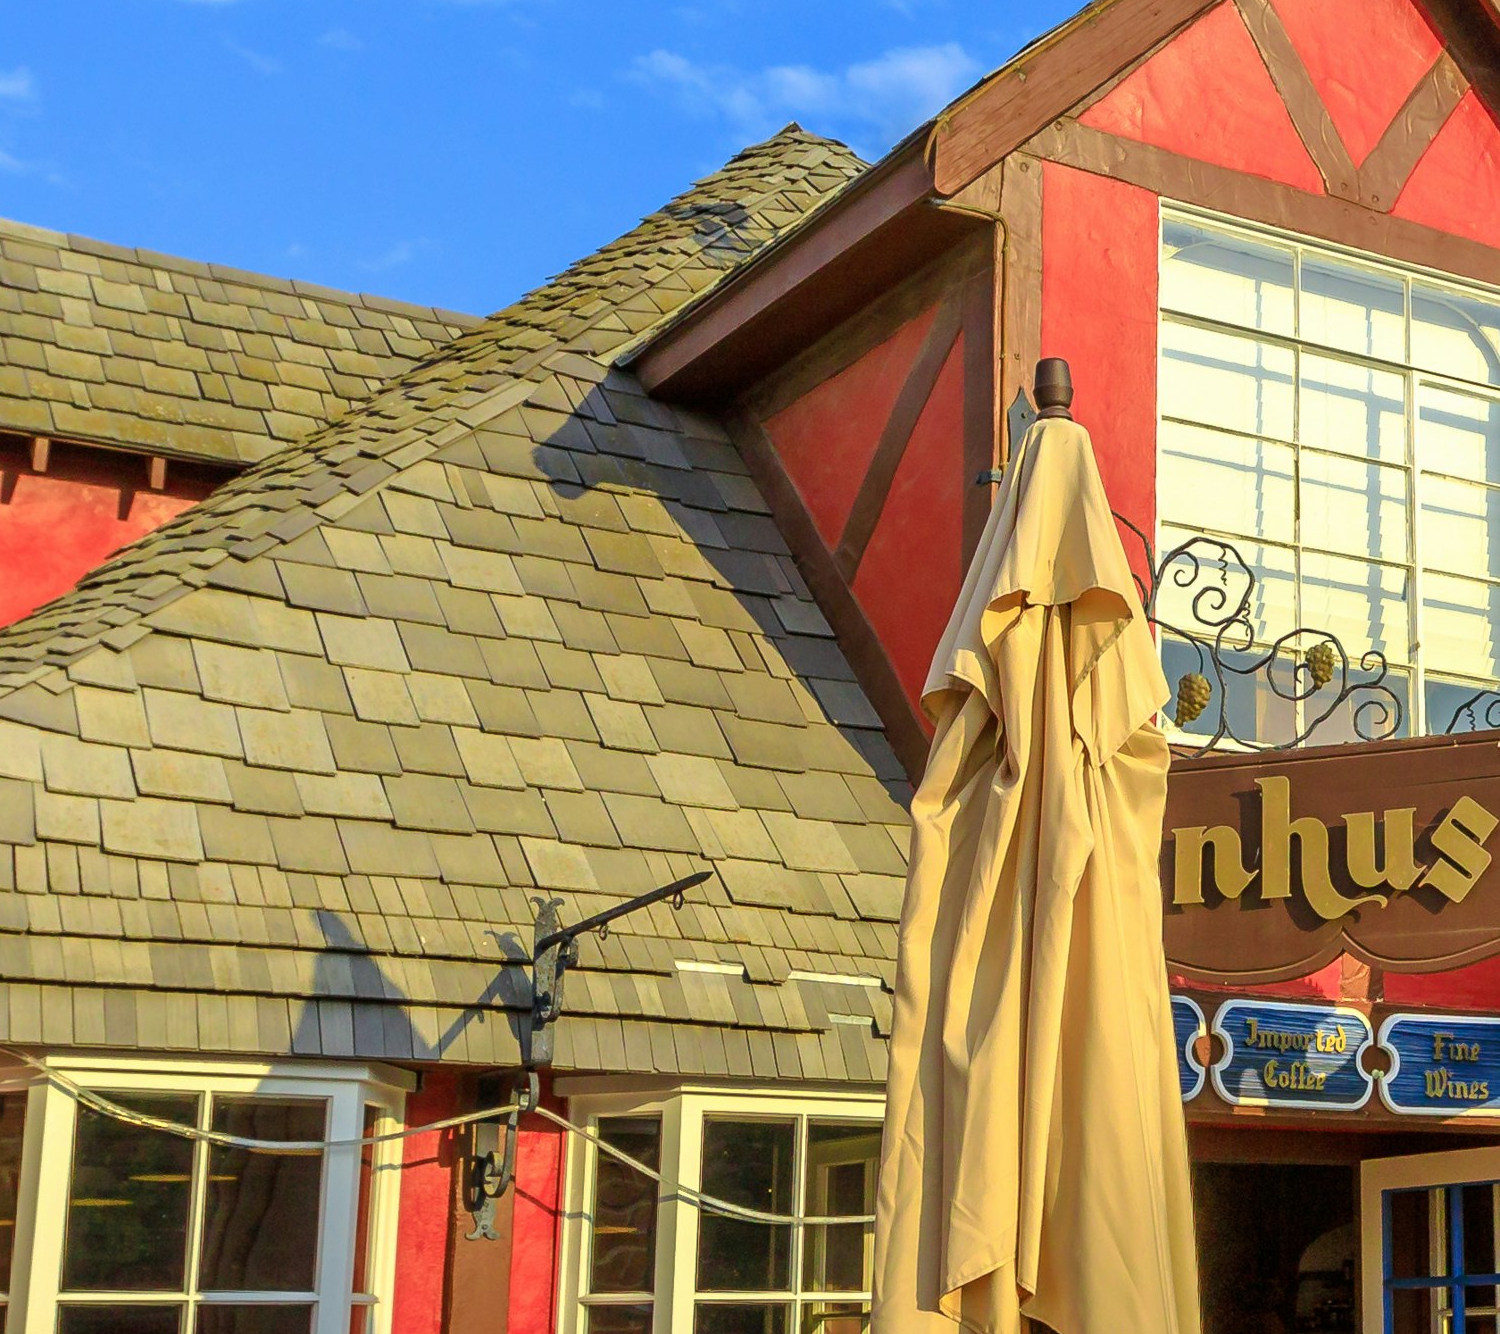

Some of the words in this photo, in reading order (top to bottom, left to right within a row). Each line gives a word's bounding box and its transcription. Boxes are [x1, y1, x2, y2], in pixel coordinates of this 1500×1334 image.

[1171, 775, 1500, 920] nhus
[1244, 1018, 1347, 1053] Imported
[1432, 1033, 1481, 1062] Fine
[1263, 1059, 1327, 1090] Coffee
[1424, 1067, 1490, 1100] Wines
